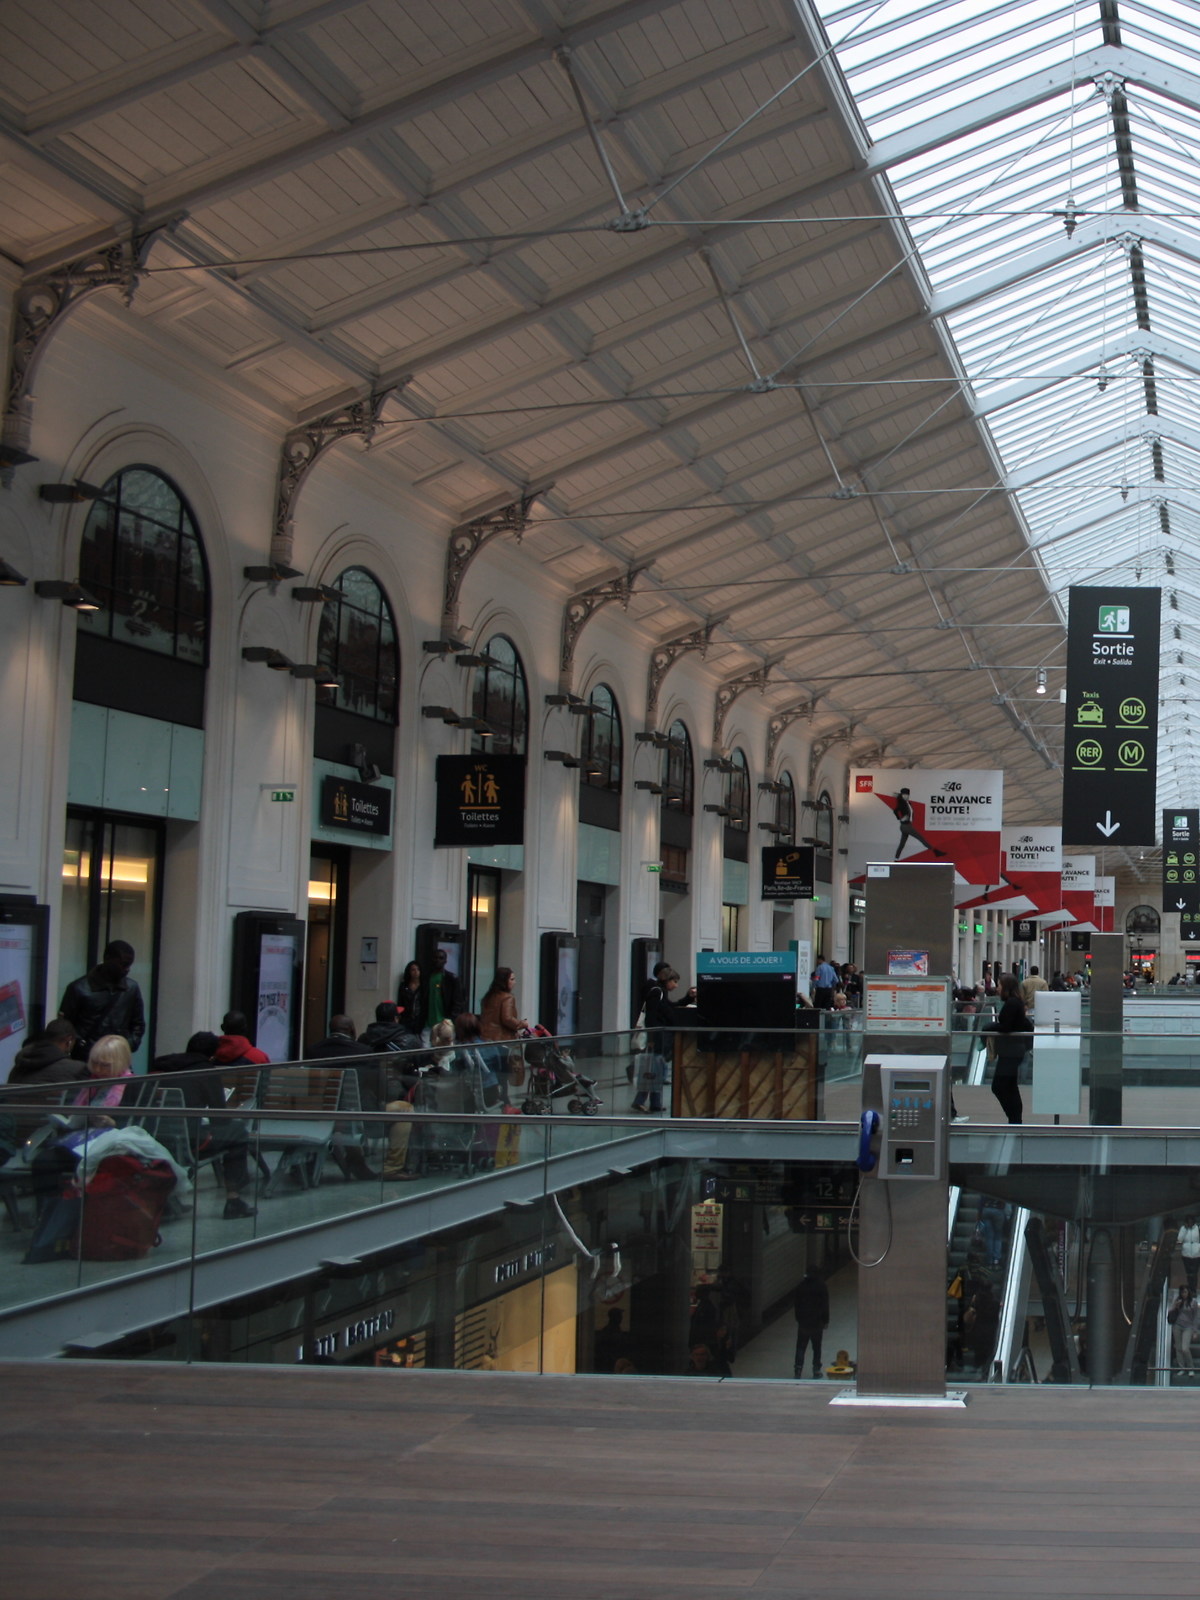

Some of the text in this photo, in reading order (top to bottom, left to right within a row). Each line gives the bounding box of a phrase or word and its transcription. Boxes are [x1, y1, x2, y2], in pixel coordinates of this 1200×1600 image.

[1091, 641, 1135, 657] Sortie
[1093, 658, 1133, 666] Exit Salida
[1082, 691, 1100, 699] Taxis
[1121, 703, 1144, 717] BUS
[1079, 746, 1100, 759] RER
[1123, 746, 1140, 761] M
[473, 764, 488, 772] WC
[859, 780, 873, 788] SFR
[930, 796, 993, 805] EN AVANCE
[350, 797, 380, 816] Toilettes
[459, 811, 500, 822] Toilettes
[1171, 830, 1190, 838] Sortie
[717, 957, 739, 965] VOUS
[740, 957, 752, 965] DE
[752, 957, 778, 965] JOUER
[815, 1183, 834, 1197] 12
[345, 1310, 394, 1347] BATEAU
